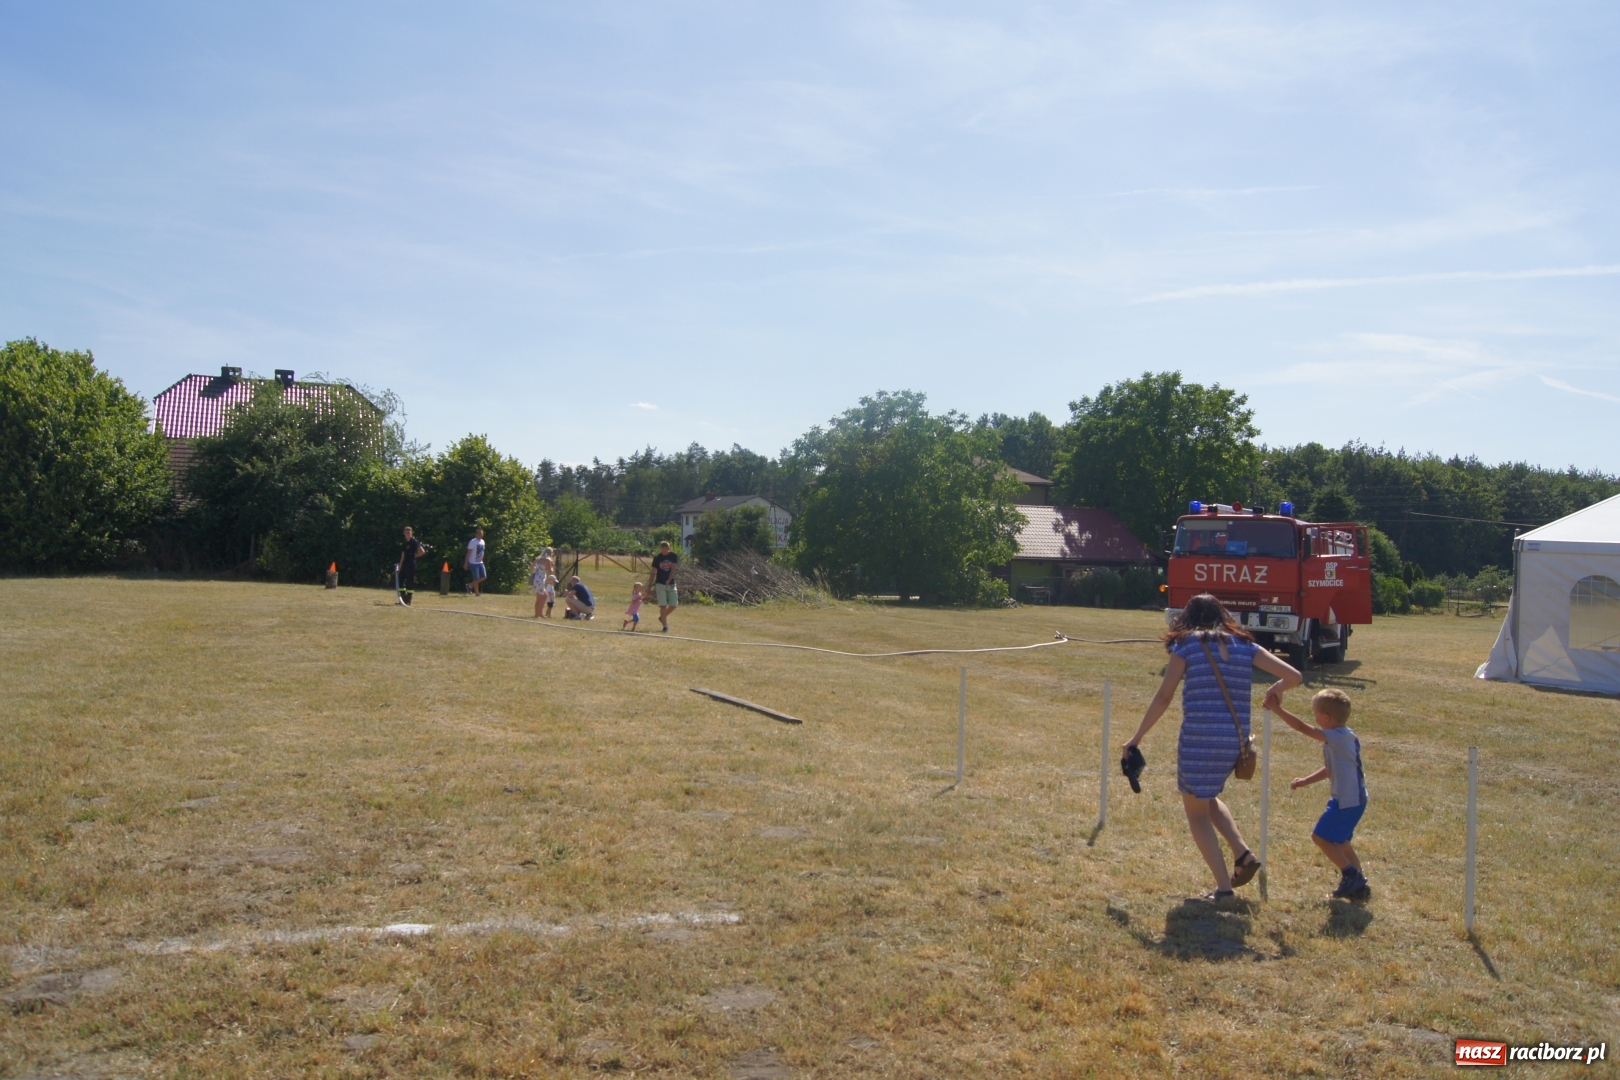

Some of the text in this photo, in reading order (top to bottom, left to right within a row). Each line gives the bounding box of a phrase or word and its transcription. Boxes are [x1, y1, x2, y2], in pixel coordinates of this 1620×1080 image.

[770, 517, 789, 525] LACJA
[1325, 562, 1338, 570] OSP
[1308, 579, 1344, 587] SZYMOCICE
